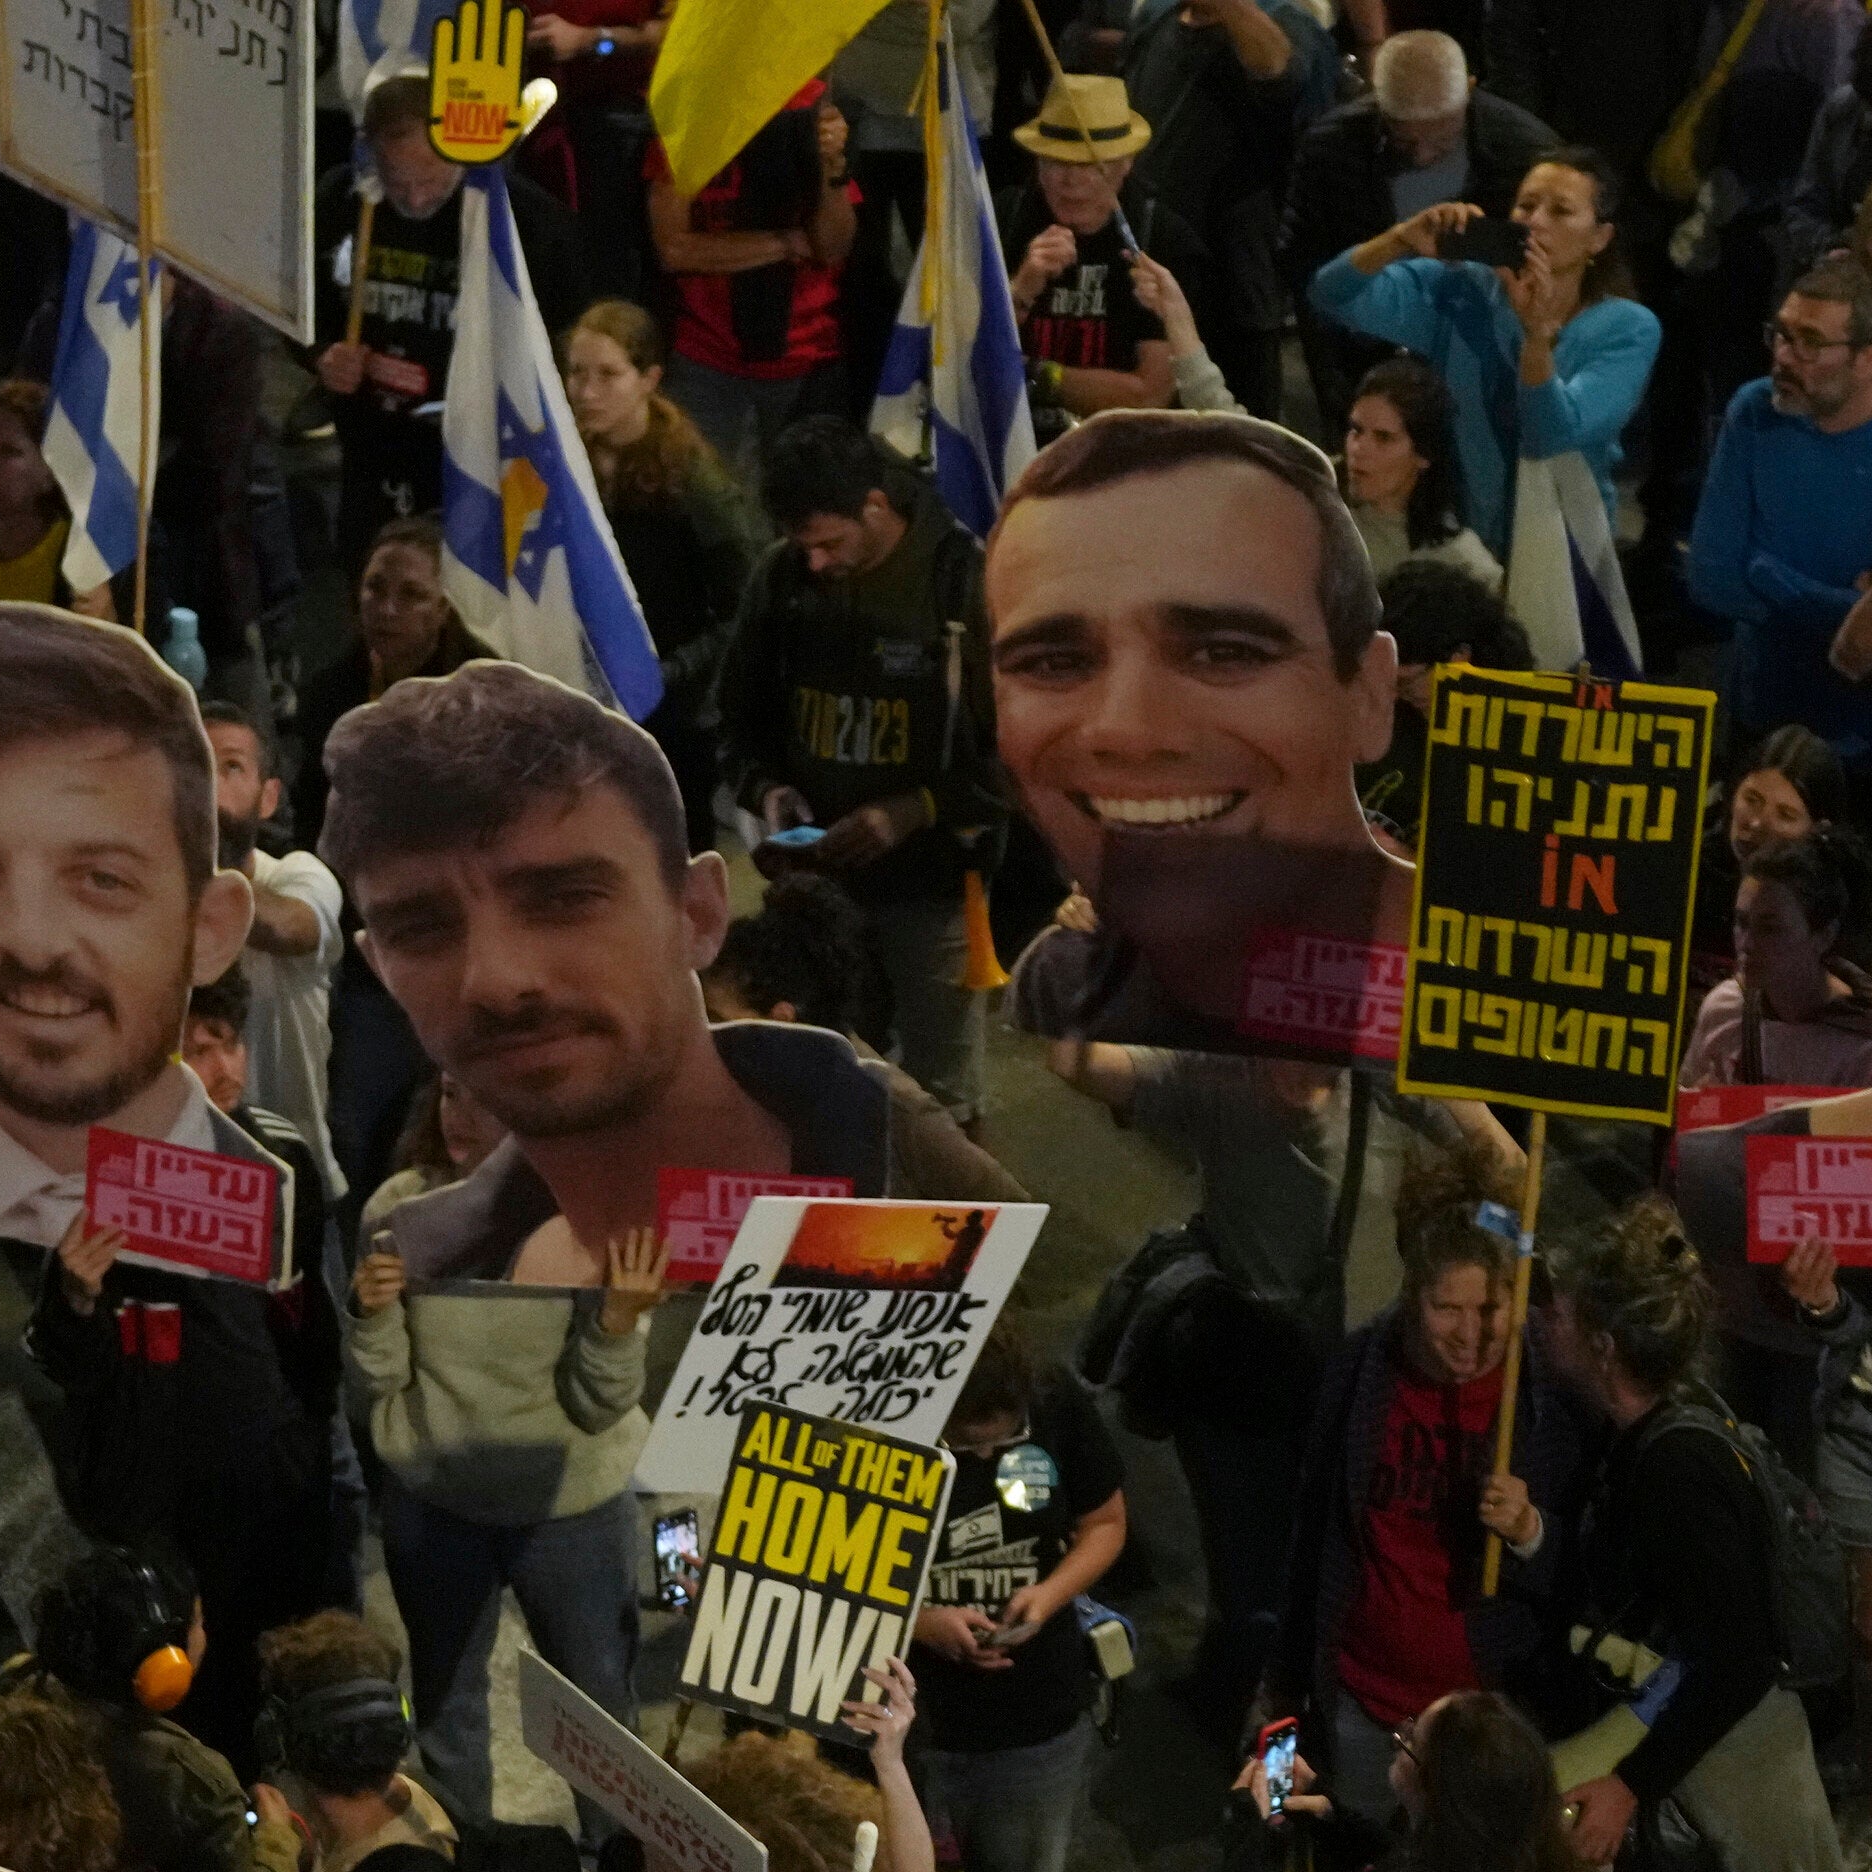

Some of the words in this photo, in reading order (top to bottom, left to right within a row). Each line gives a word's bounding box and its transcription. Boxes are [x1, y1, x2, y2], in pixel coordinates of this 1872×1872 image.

[443, 101, 508, 136] NOW
[1429, 688, 1697, 771] הישרדות
[1464, 762, 1679, 844] נתניהו
[1414, 902, 1675, 997] הישרדות
[1416, 980, 1673, 1080] החטופים
[144, 1148, 261, 1205] עדיין
[111, 1195, 257, 1257] בעזה.
[864, 1291, 988, 1340] אנחנו
[720, 1337, 795, 1386] לא
[739, 1410, 817, 1478] ALL
[812, 1438, 843, 1470] OF
[836, 1434, 945, 1512] THEM
[713, 1463, 930, 1609] HOME
